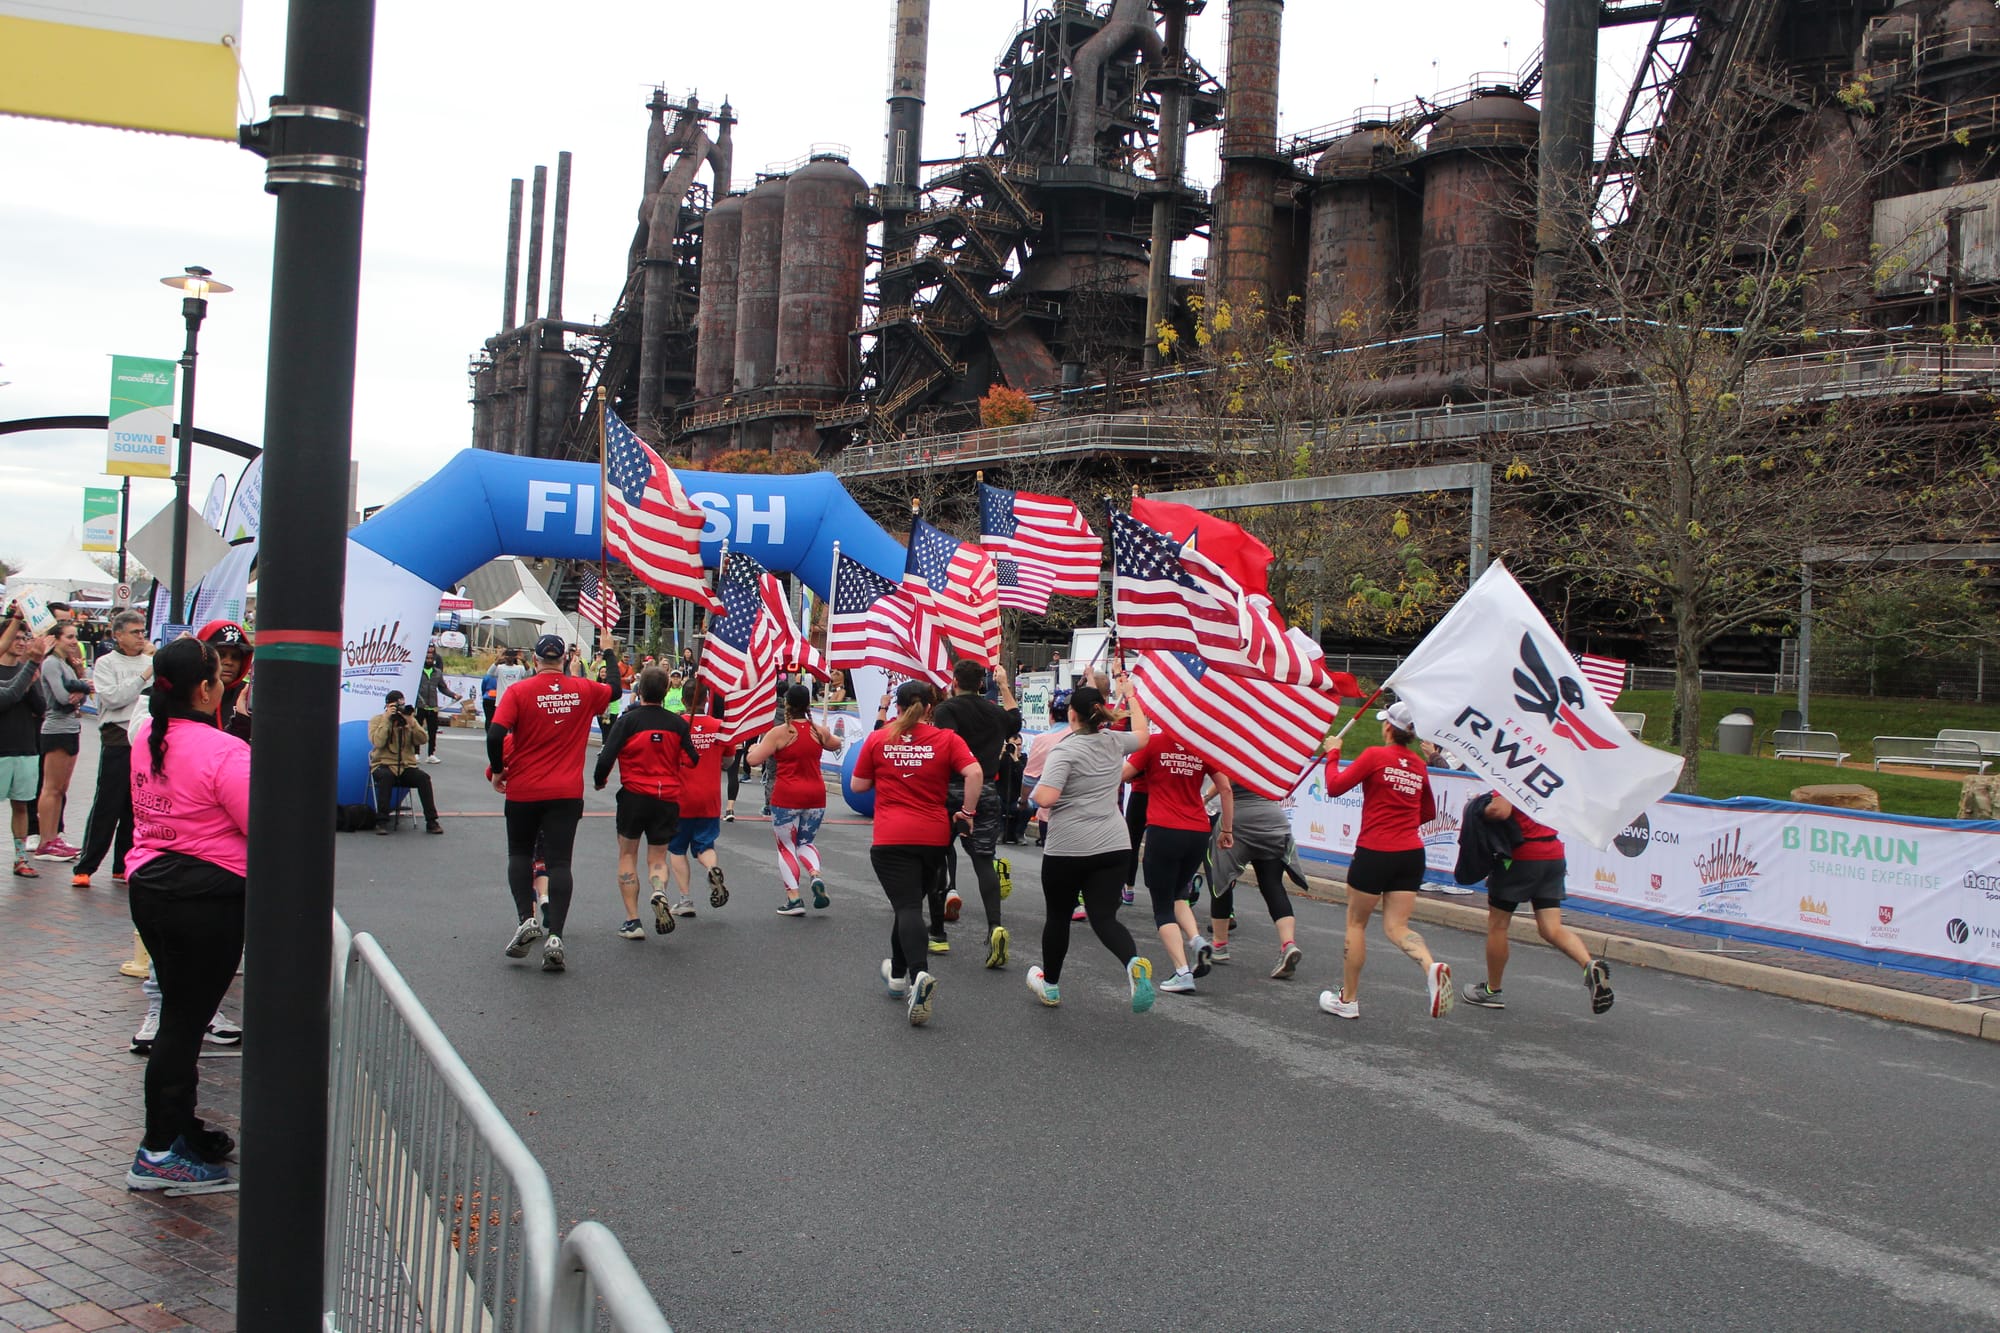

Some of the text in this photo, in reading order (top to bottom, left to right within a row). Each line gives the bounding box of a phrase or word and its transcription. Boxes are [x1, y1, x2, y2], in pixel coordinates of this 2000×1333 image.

[114, 432, 153, 443] TOWN
[114, 443, 166, 455] SQUARE
[526, 480, 786, 545] FISH
[537, 693, 579, 702] ENRICHING
[1024, 692, 1043, 703] Second
[1032, 703, 1046, 714] Wind
[1504, 717, 1548, 756] TEAM
[1160, 753, 1203, 764] ENRICHING
[1454, 706, 1564, 798] RWB
[1170, 767, 1194, 776] LIVES
[1384, 767, 1423, 783] ENRICHING
[1434, 729, 1545, 814] LEHIGH VALLEY
[1392, 783, 1416, 795] LIVES
[132, 788, 173, 814] UBBER
[1782, 826, 1919, 865] B BRAUN
[1694, 828, 1761, 885] Bethlehem
[1808, 859, 1942, 890] SHARING EXPERTISE
[1972, 925, 2000, 939] WIN
